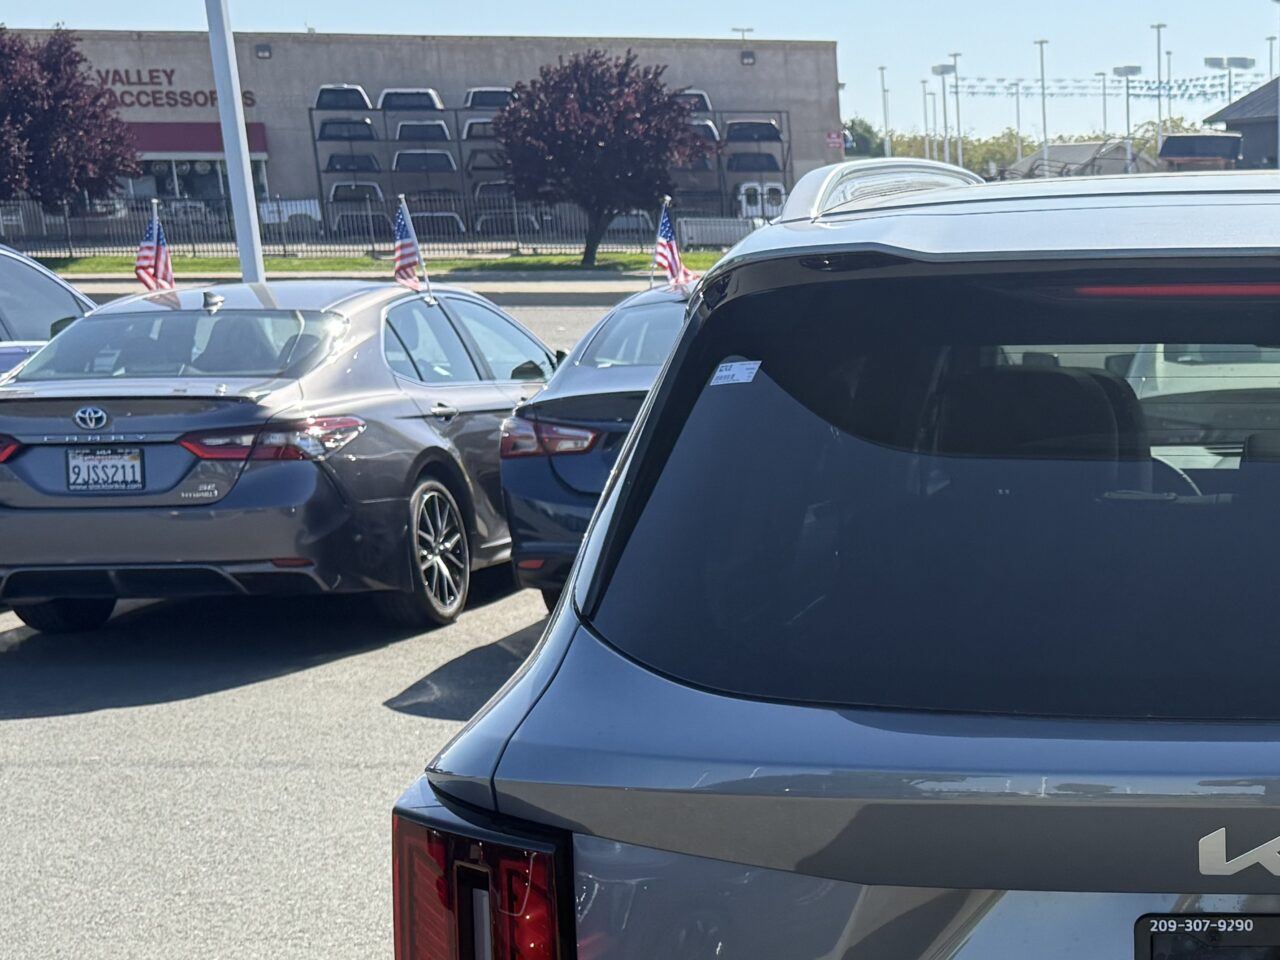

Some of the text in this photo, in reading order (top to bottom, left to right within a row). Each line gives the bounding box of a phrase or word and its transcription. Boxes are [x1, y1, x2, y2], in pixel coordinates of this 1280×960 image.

[97, 69, 175, 86] VALLEY
[104, 90, 257, 107] ACCESSOS
[72, 464, 138, 485] 9JSS211
[1149, 918, 1254, 933] 209-307-9290
